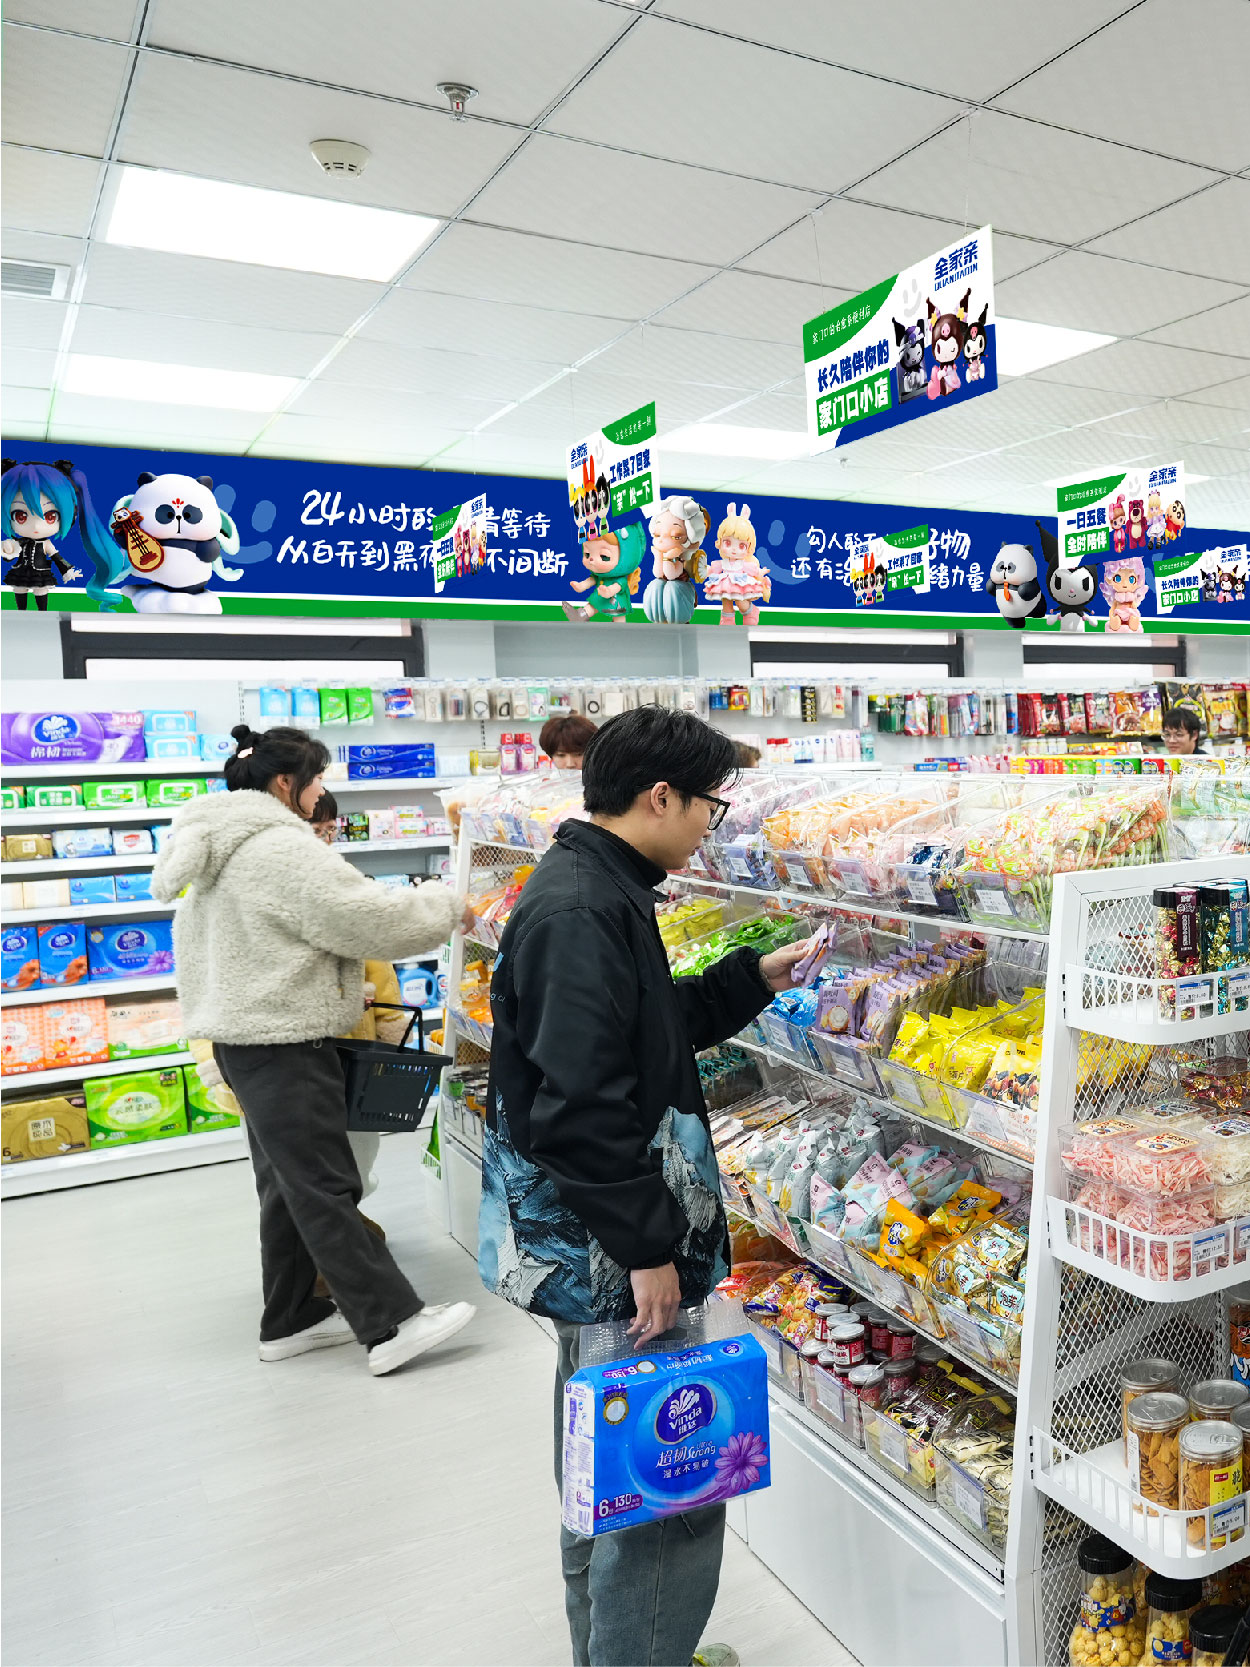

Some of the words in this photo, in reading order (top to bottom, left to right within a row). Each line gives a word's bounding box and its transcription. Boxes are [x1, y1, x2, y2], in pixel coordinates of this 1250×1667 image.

[934, 239, 978, 281] 全家亲
[817, 338, 889, 392] 长久陪伴你的
[818, 376, 889, 430] 家门口小店
[1149, 466, 1177, 483] 全家亲
[1067, 507, 1107, 530] 一日五餐
[1067, 531, 1107, 554] 全时陪伴
[669, 1406, 703, 1430] Vinda
[678, 1420, 697, 1435] 维达
[656, 1446, 688, 1468] 超韧
[663, 1459, 709, 1479] 湿水不易破
[599, 1499, 609, 1517] 6
[614, 1493, 633, 1508] 130
